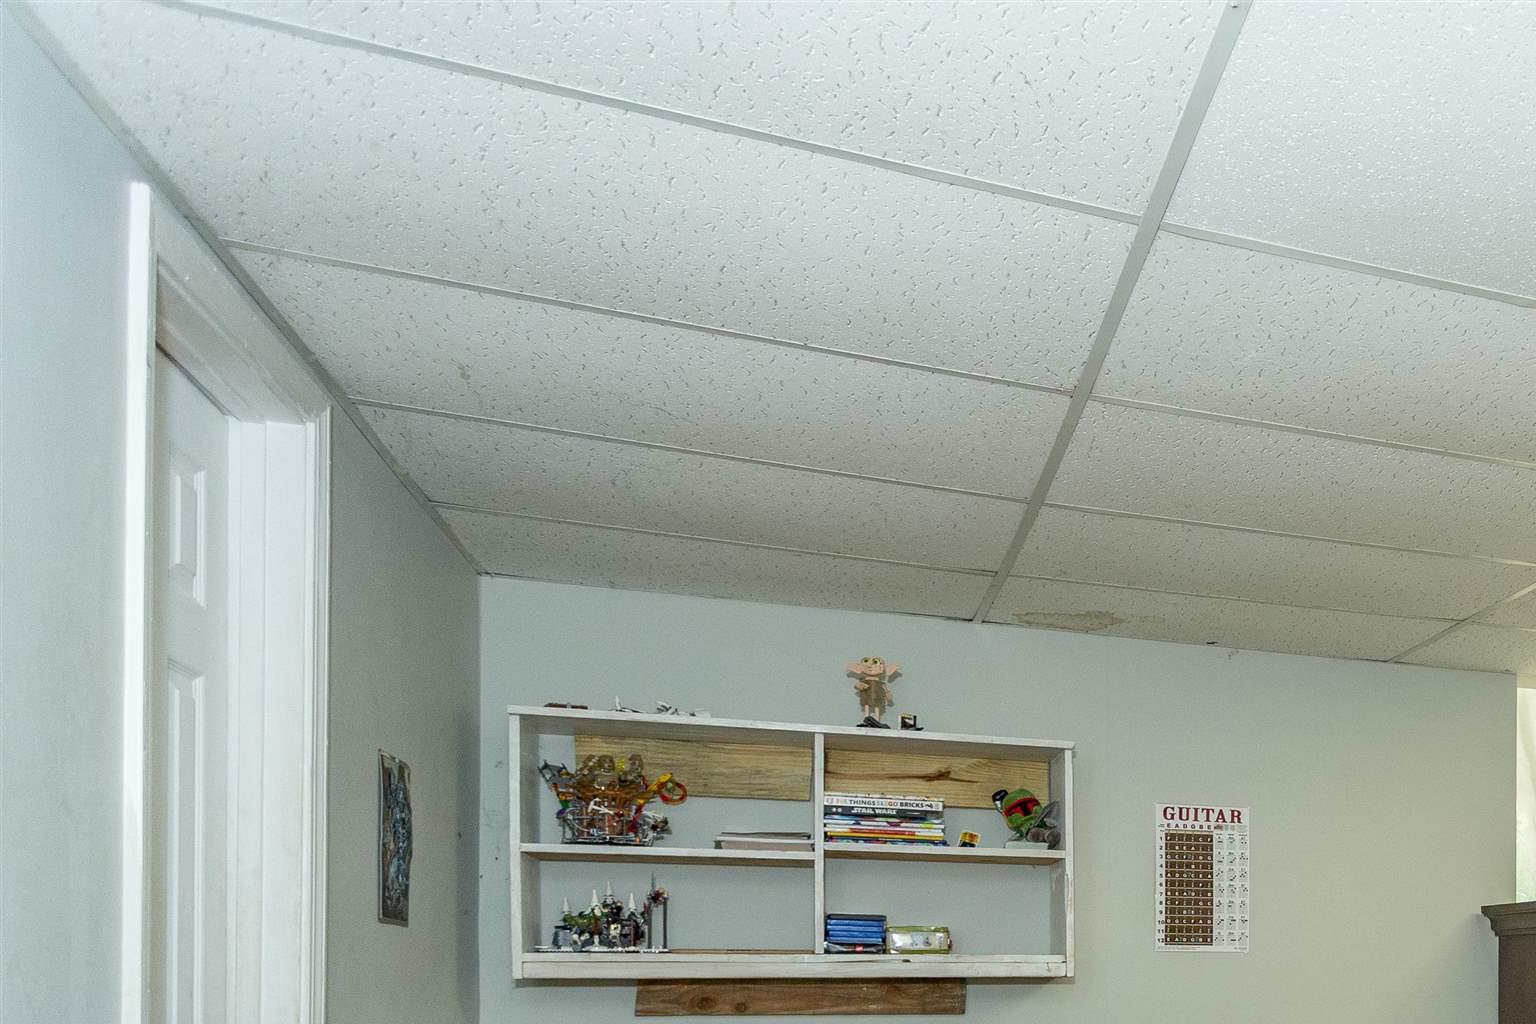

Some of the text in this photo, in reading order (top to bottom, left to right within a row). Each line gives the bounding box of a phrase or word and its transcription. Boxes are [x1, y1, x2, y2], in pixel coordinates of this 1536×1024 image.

[849, 799, 876, 807] THINGS
[900, 801, 924, 809] BRICKS
[1163, 806, 1243, 824] GUITAR
